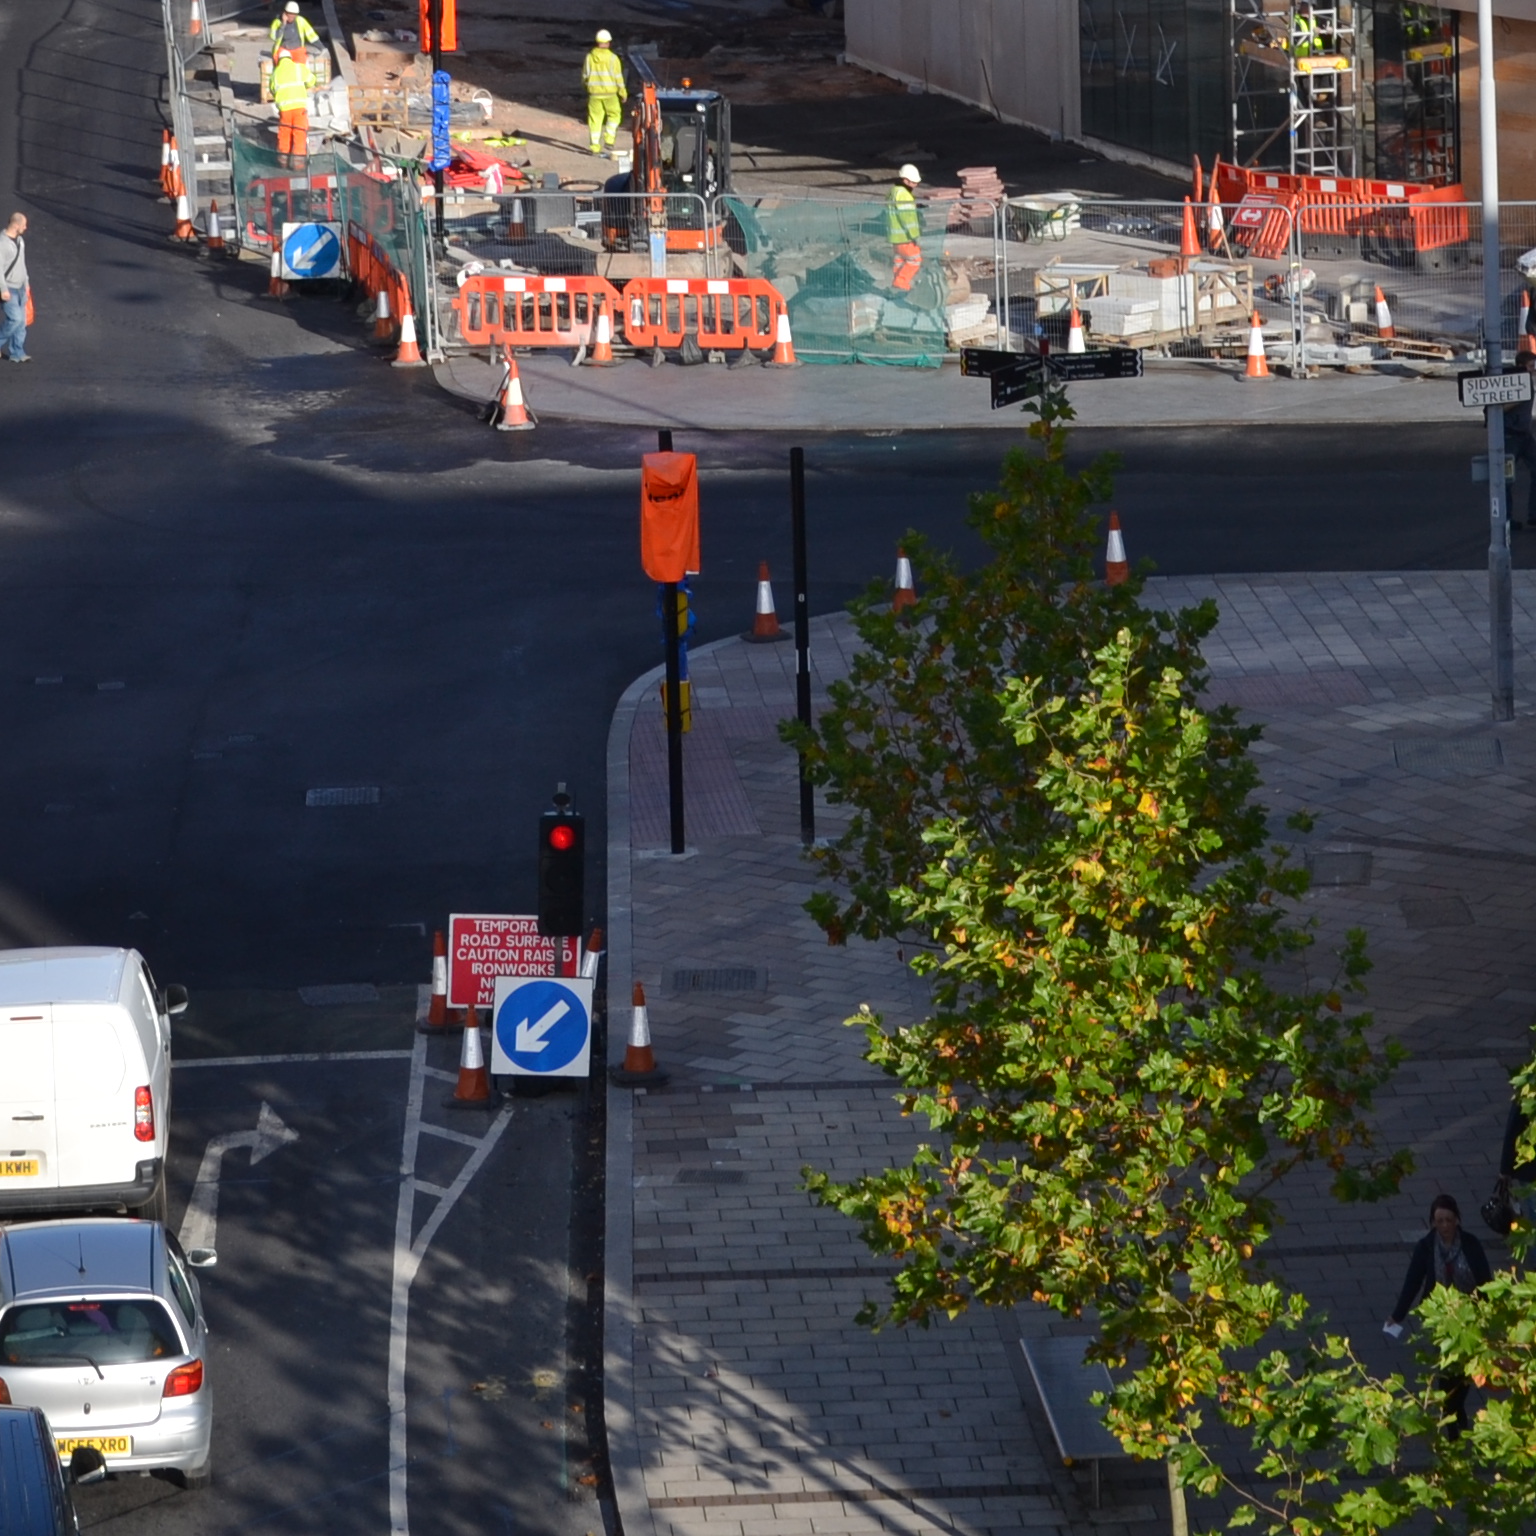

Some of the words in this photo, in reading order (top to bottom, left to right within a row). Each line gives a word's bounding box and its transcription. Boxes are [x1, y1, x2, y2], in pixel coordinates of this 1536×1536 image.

[1467, 375, 1524, 391] SIDWELL
[1472, 389, 1523, 405] STREET
[474, 920, 539, 933] TEMPORA
[460, 934, 501, 947] ROAD
[456, 948, 519, 961] CAUTION
[523, 949, 573, 962] RAISD
[471, 962, 555, 976] IRONWORKS
[5, 1161, 31, 1174] KWH
[99, 1437, 127, 1452] XRO
